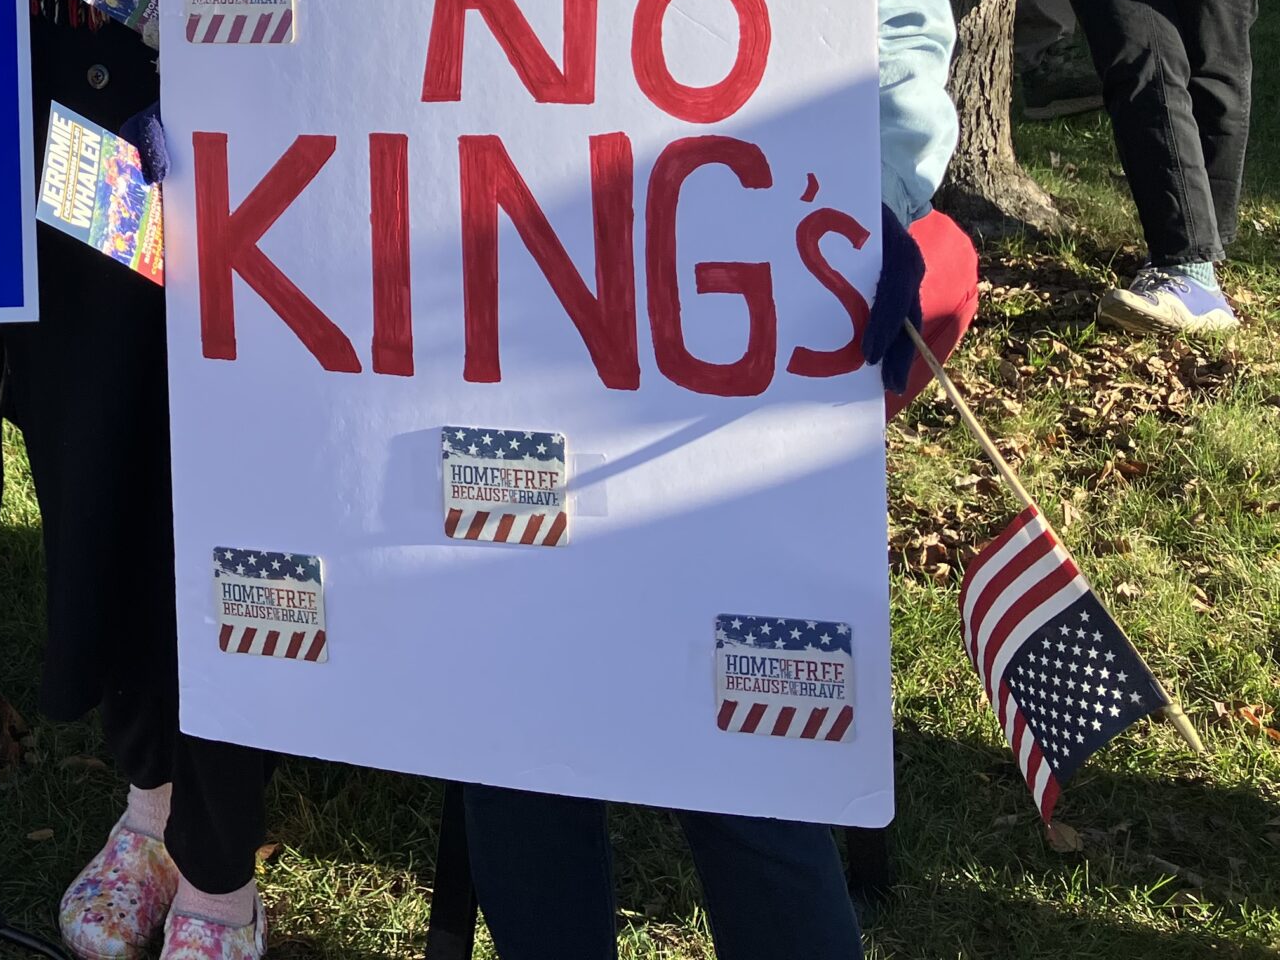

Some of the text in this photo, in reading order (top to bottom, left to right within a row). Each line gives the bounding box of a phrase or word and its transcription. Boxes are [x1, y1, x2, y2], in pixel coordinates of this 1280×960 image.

[42, 111, 73, 217] JEROMIE
[70, 127, 101, 229] WHALEN
[451, 464, 500, 487] HOME
[512, 469, 559, 491] FREE
[451, 484, 509, 502] BECAUSE
[518, 489, 560, 506] BRAVE
[222, 582, 265, 605] HOME
[275, 588, 317, 610] FREE
[223, 601, 273, 620] BECAUSE
[281, 608, 318, 625] BRAVE
[725, 654, 779, 678] HOME
[793, 660, 844, 683] FREE
[726, 675, 788, 695] BECAUSE
[800, 681, 845, 700] BRAVE
